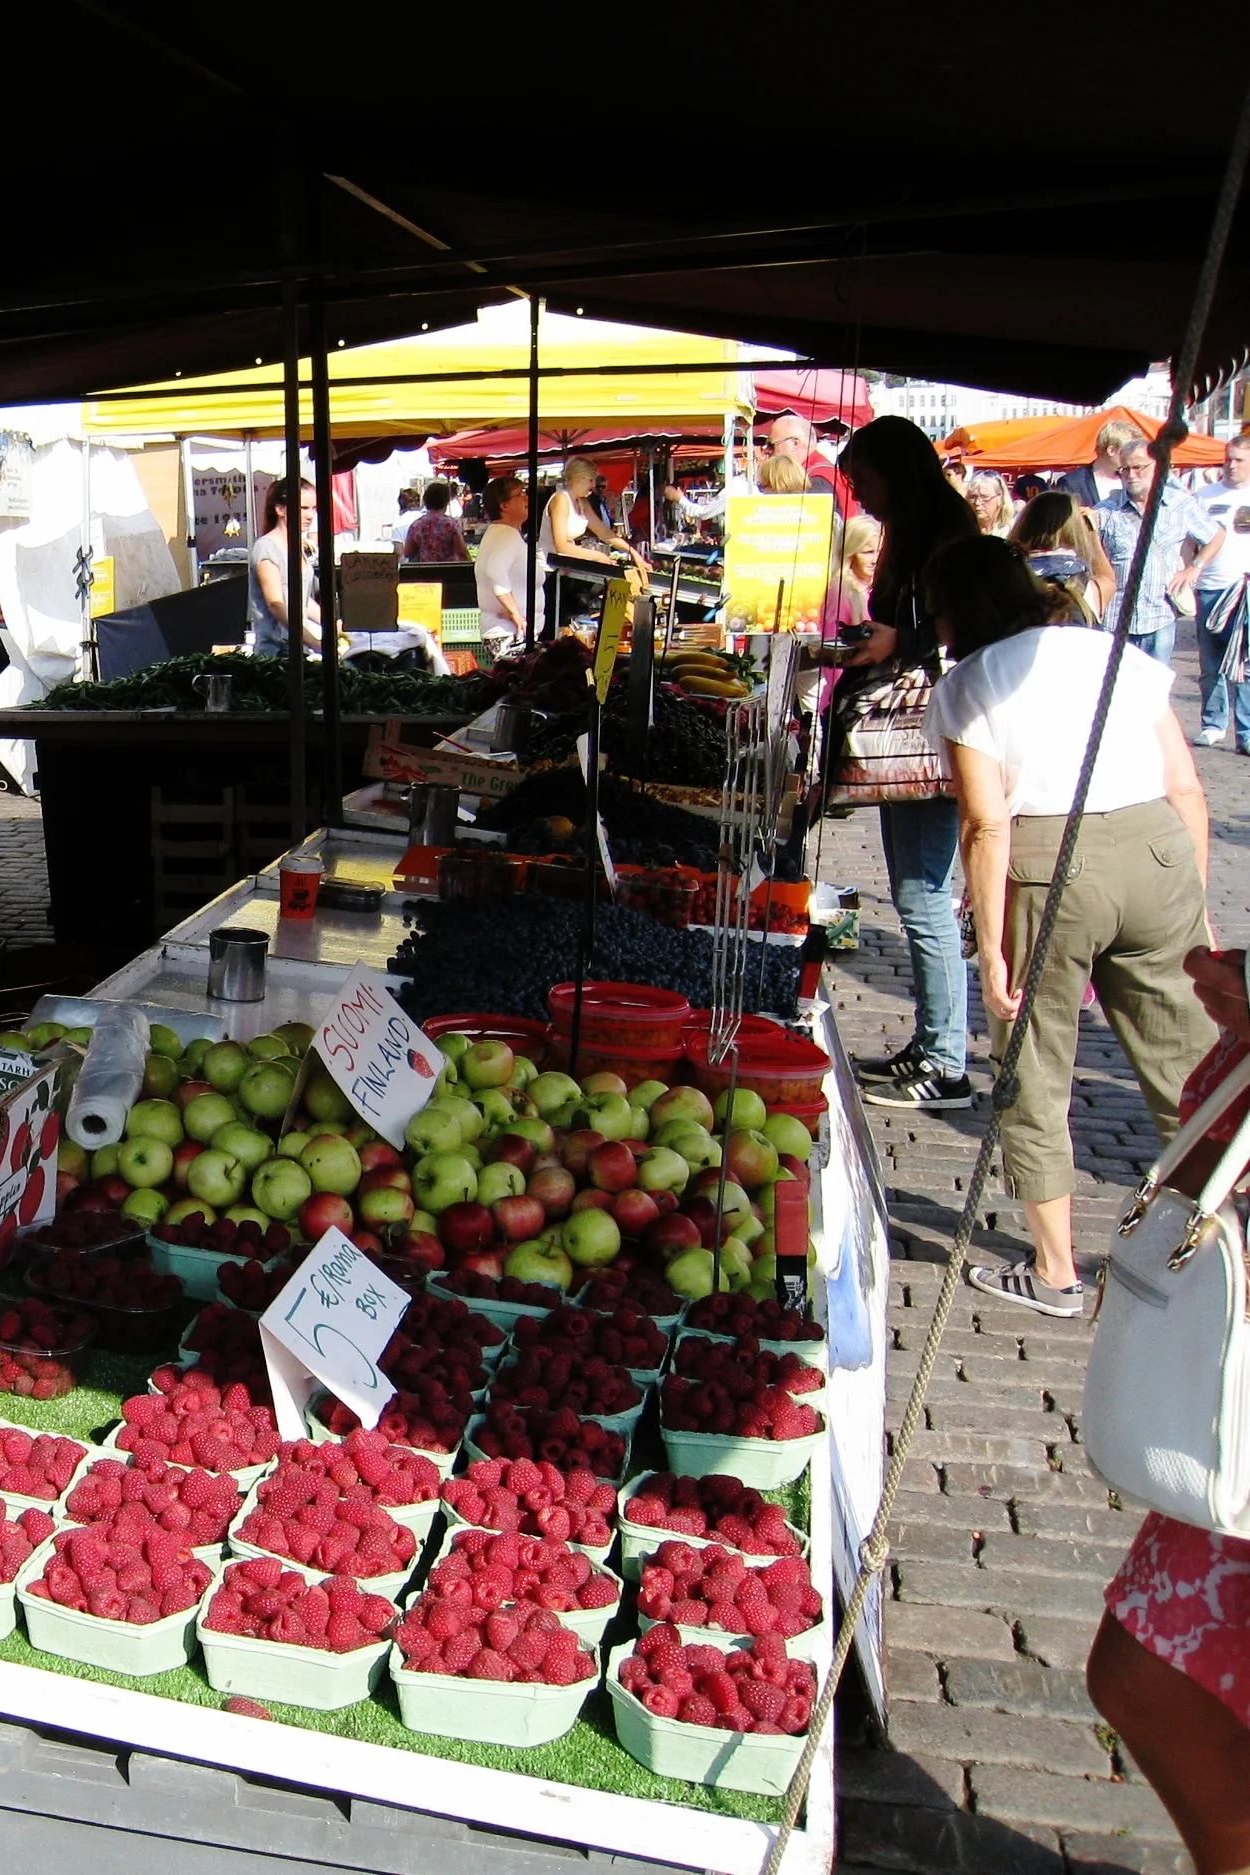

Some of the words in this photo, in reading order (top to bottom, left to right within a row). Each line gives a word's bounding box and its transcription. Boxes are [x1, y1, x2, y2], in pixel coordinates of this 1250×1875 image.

[461, 772, 485, 787] The
[354, 1283, 387, 1321] BOX
[283, 1286, 378, 1390] 5
